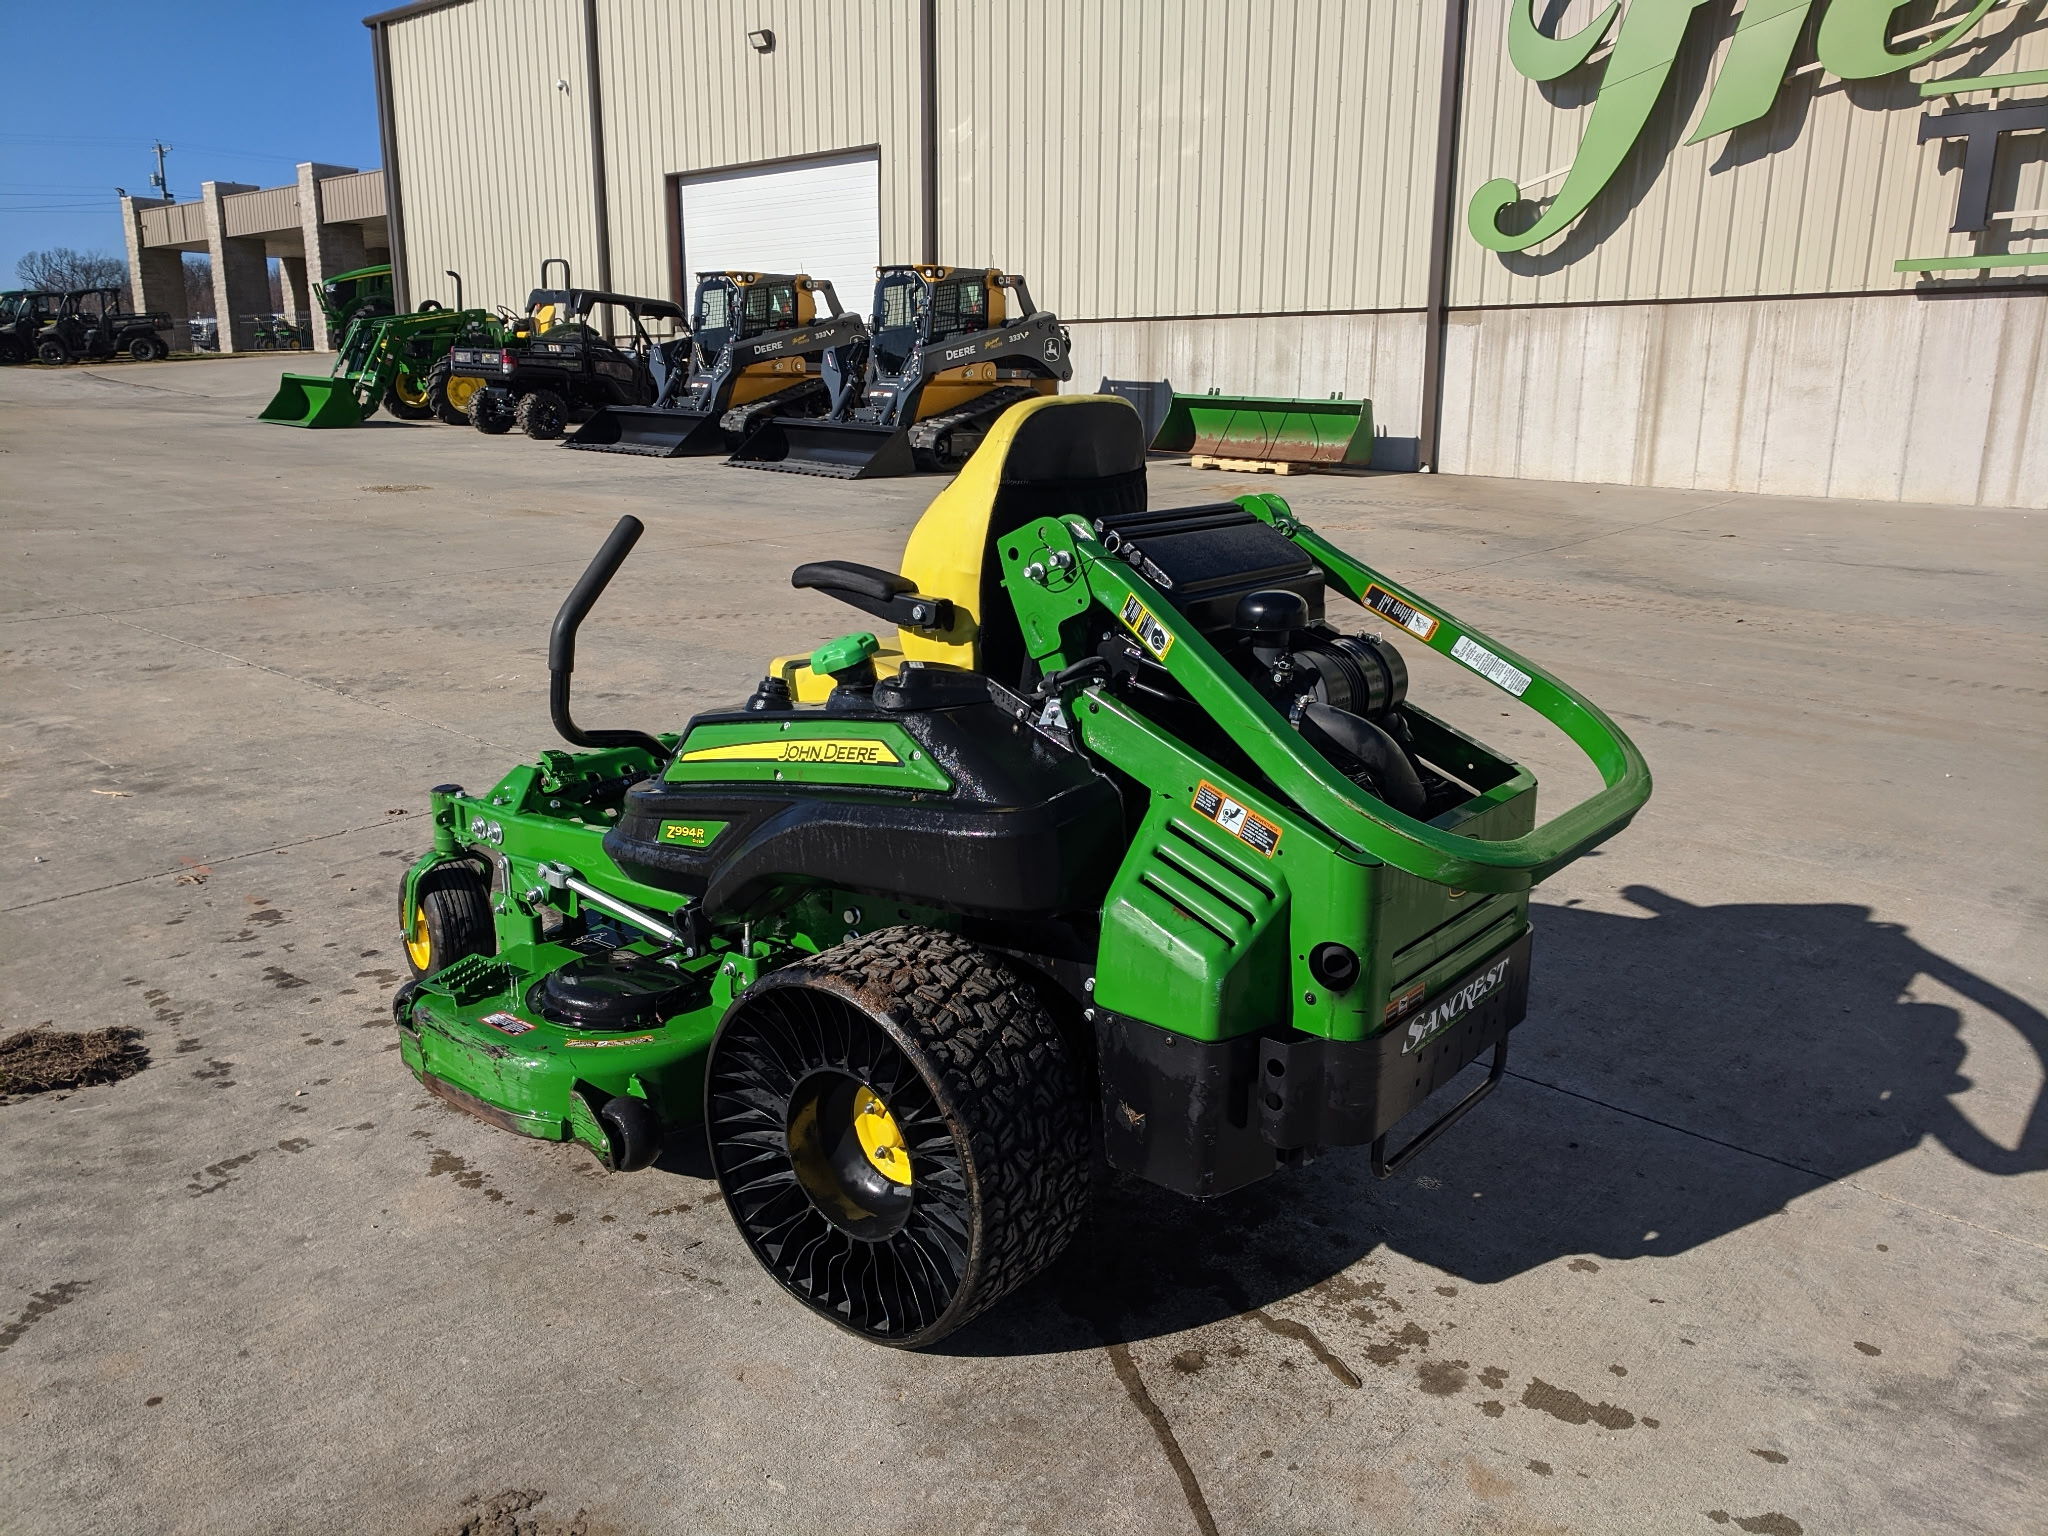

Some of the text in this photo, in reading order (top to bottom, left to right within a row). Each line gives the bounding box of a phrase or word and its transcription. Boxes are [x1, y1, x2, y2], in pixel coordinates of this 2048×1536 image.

[753, 341, 784, 355] DEERE
[945, 344, 976, 361] DEERE
[778, 742, 880, 761] JOHN DEERE
[666, 825, 705, 839] Z994R
